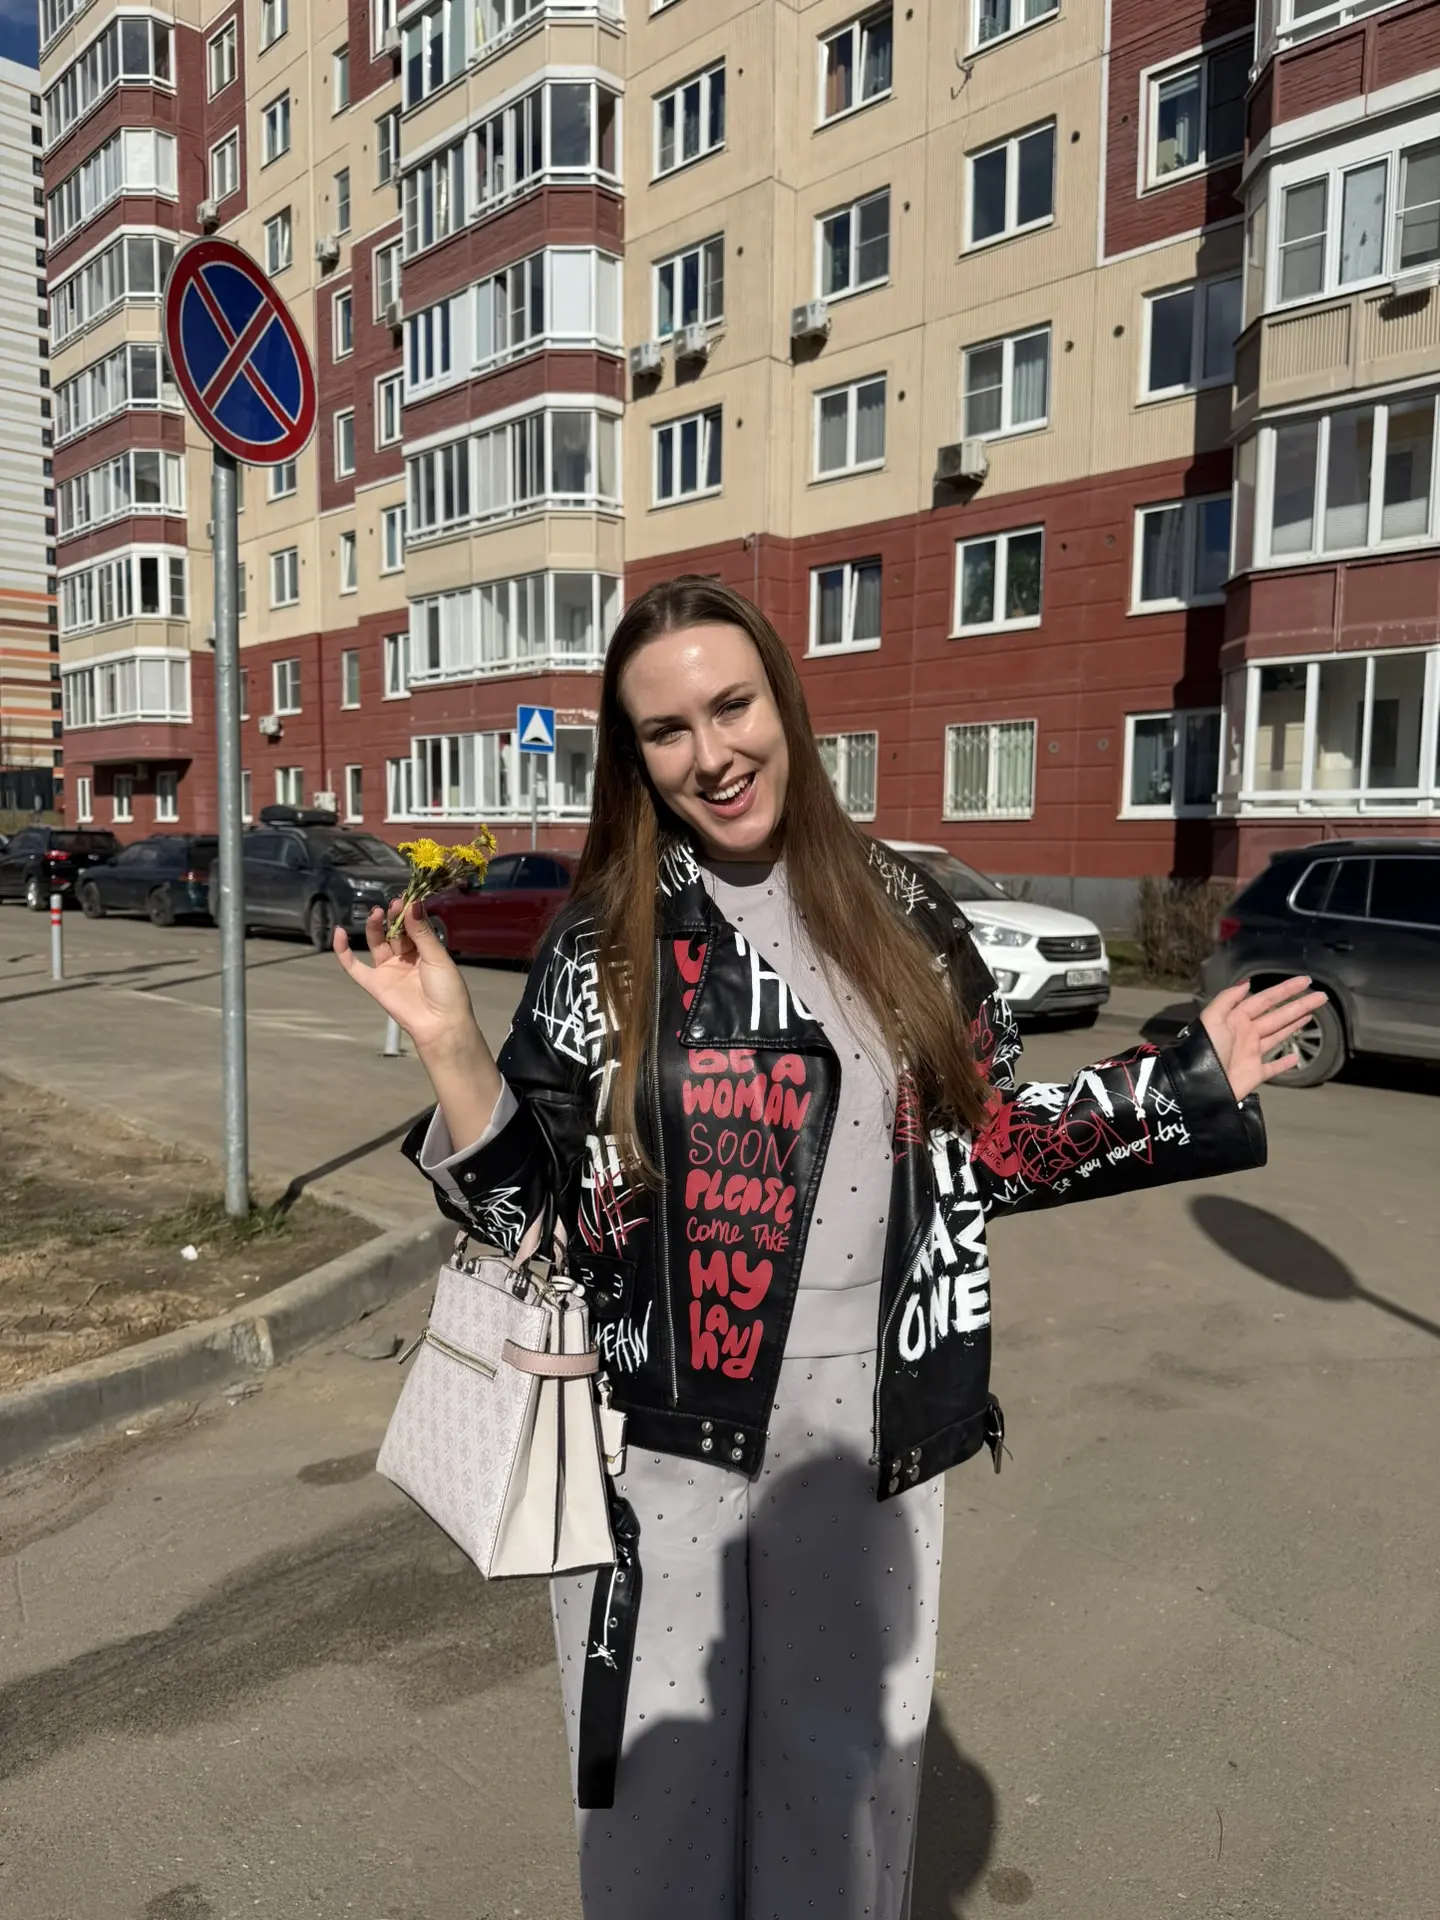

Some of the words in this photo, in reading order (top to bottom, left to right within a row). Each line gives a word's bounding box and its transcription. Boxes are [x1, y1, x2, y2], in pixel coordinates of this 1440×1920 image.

[771, 1053, 806, 1085] A
[682, 1073, 812, 1131] WOMAN
[898, 1270, 991, 1361] ONE
